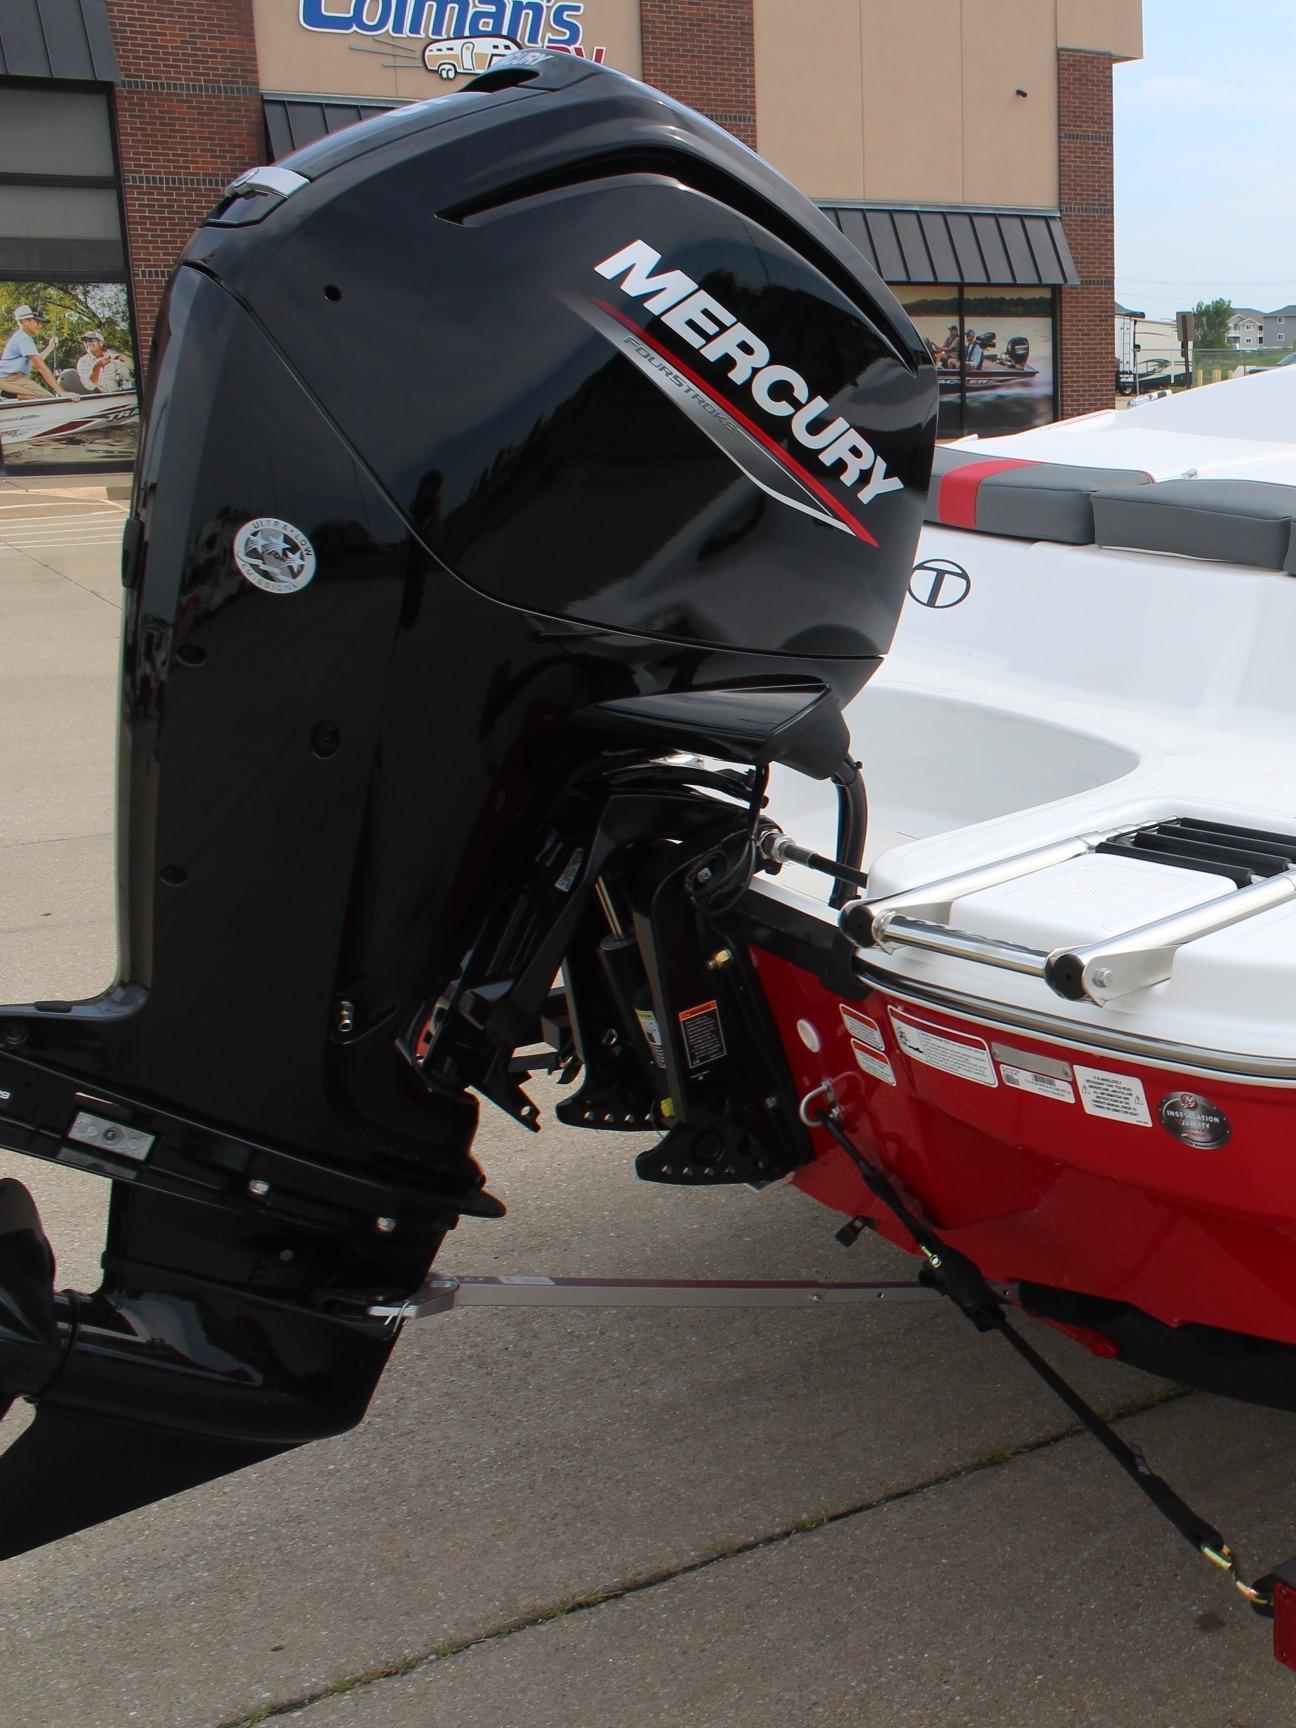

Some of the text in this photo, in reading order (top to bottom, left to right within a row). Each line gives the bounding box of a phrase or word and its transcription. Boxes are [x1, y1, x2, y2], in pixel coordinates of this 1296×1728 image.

[297, 0, 585, 48] Colmans
[593, 239, 904, 505] MERCURY
[622, 335, 741, 433] FOURSTROKE
[1166, 1110, 1220, 1124] INSTATION
[1177, 1118, 1211, 1130] UAITY
